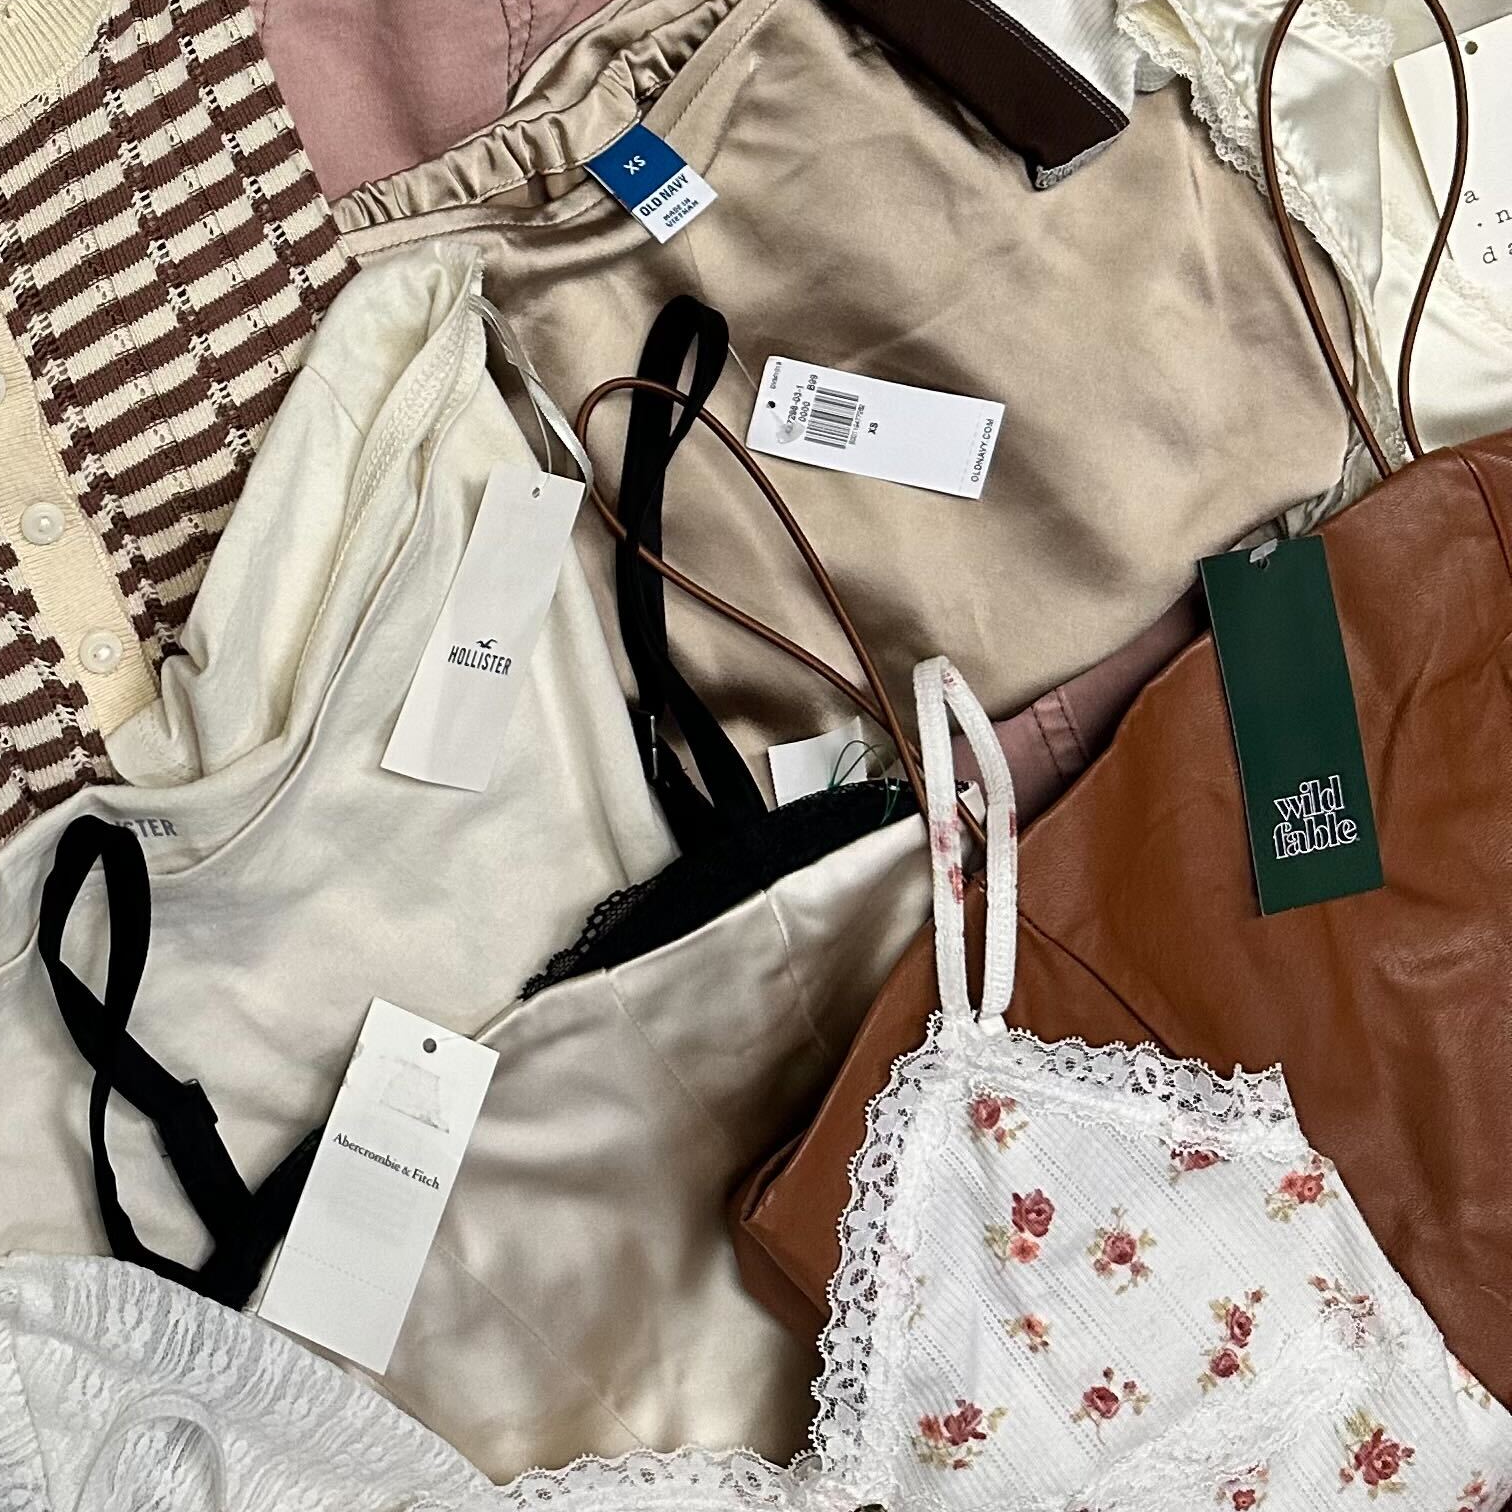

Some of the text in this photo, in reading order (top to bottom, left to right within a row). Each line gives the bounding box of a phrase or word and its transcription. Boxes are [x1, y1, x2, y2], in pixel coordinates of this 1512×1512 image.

[623, 155, 646, 176] XS
[639, 172, 689, 217] OLD NAVY
[1464, 190, 1480, 204] a
[663, 204, 682, 221] MADE
[665, 199, 699, 228] VIETNAM
[868, 422, 879, 435] XS
[447, 644, 512, 676] HOLLISTER
[1273, 774, 1345, 822] wild
[1272, 811, 1358, 860] fable
[332, 1132, 440, 1190] Abercrombie & Fitch
